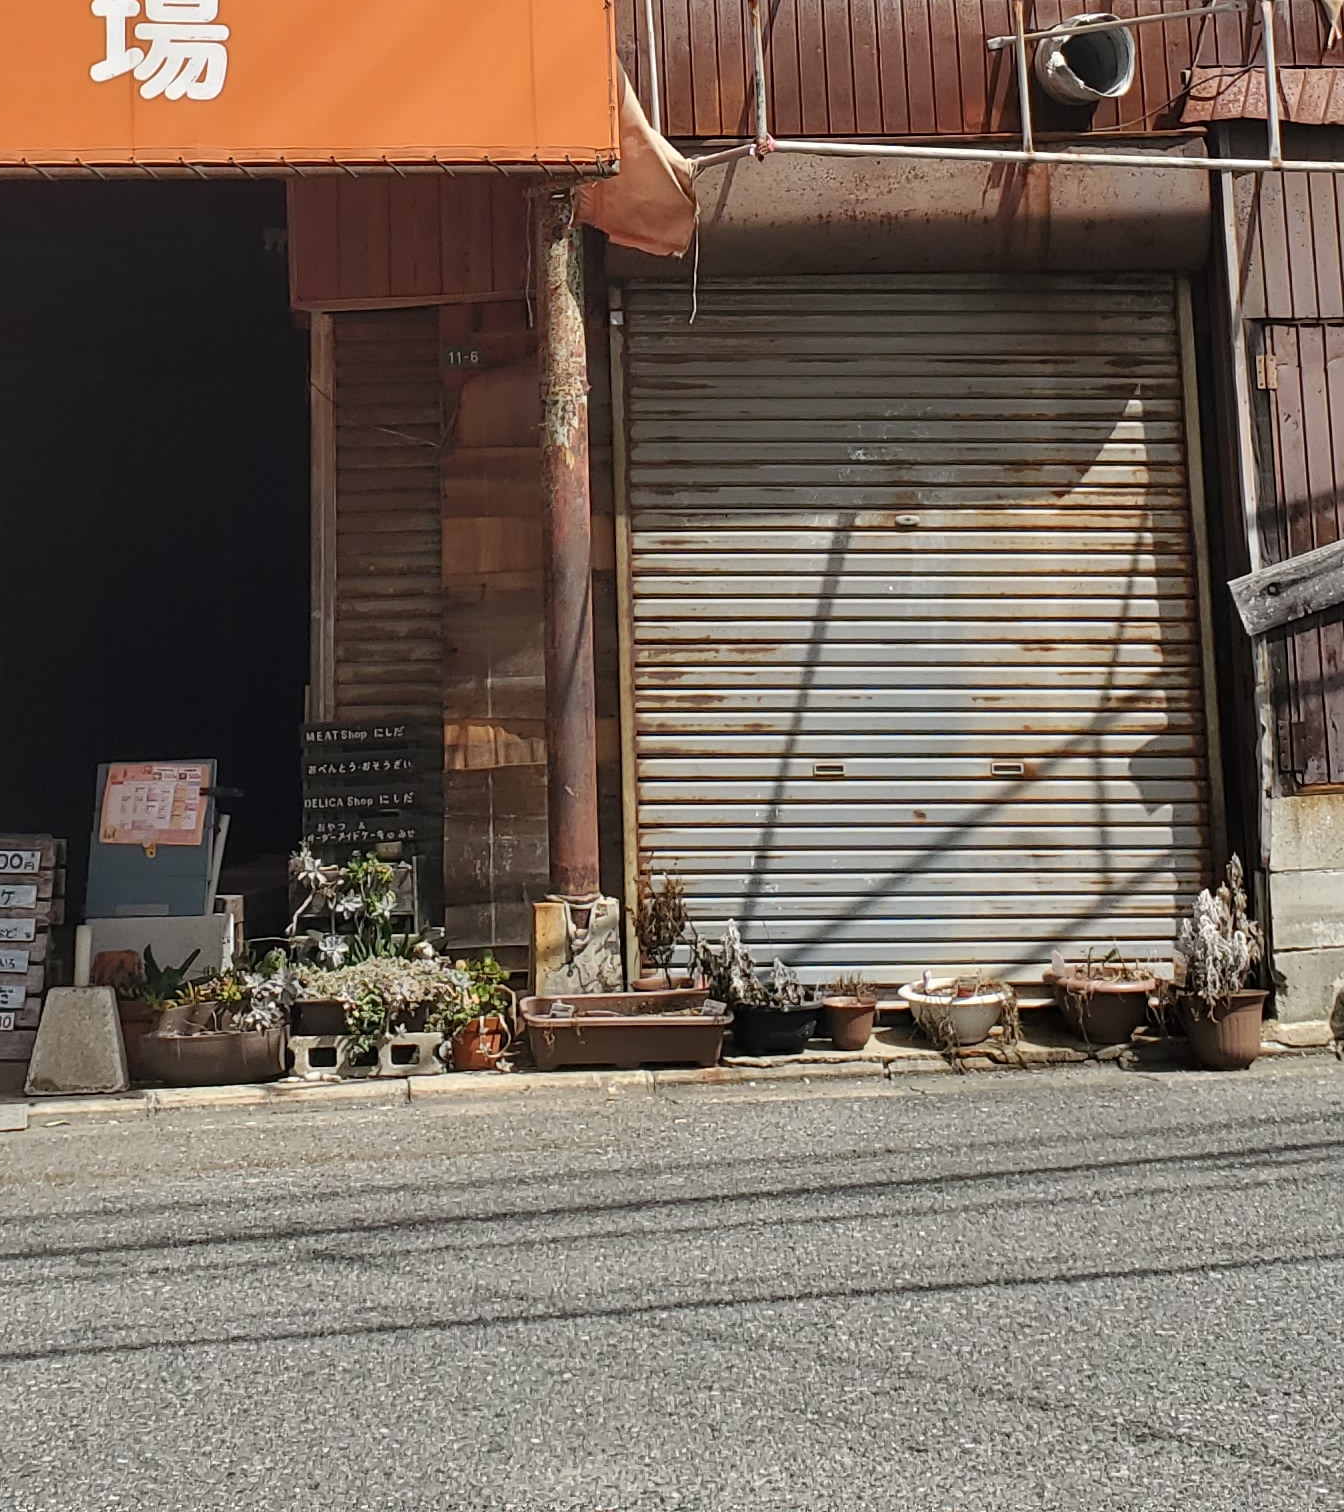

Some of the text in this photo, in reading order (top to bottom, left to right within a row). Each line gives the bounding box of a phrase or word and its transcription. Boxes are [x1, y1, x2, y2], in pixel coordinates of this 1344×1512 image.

[448, 350, 479, 365] 11-6
[306, 726, 405, 742] MEAT Shop にしだ
[304, 792, 415, 808] DELICA Shop にしだ
